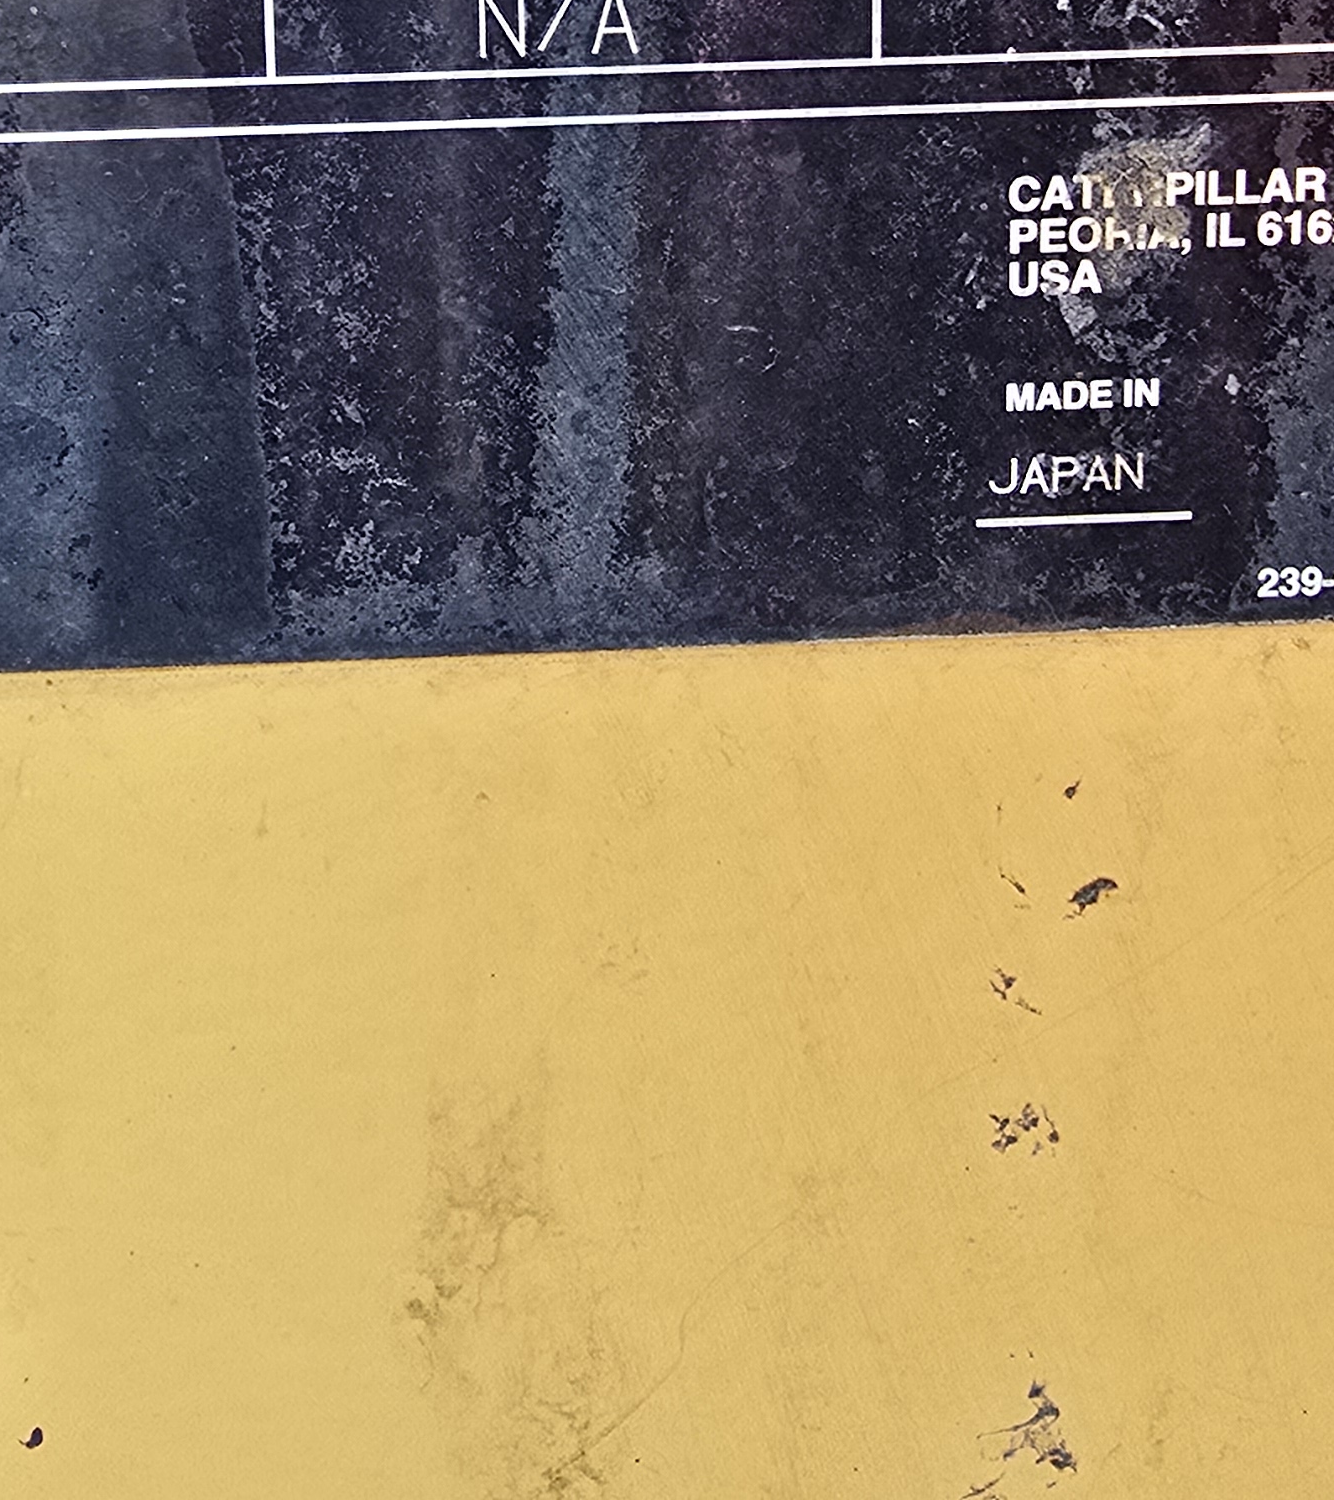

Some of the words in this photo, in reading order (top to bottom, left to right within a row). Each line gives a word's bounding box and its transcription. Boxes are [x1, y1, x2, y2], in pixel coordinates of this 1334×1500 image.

[1207, 213, 1245, 248] IL
[1008, 259, 1103, 297] USA
[1006, 380, 1114, 412] MADE
[1124, 378, 1160, 408] IN
[989, 453, 1144, 494] JAPAN
